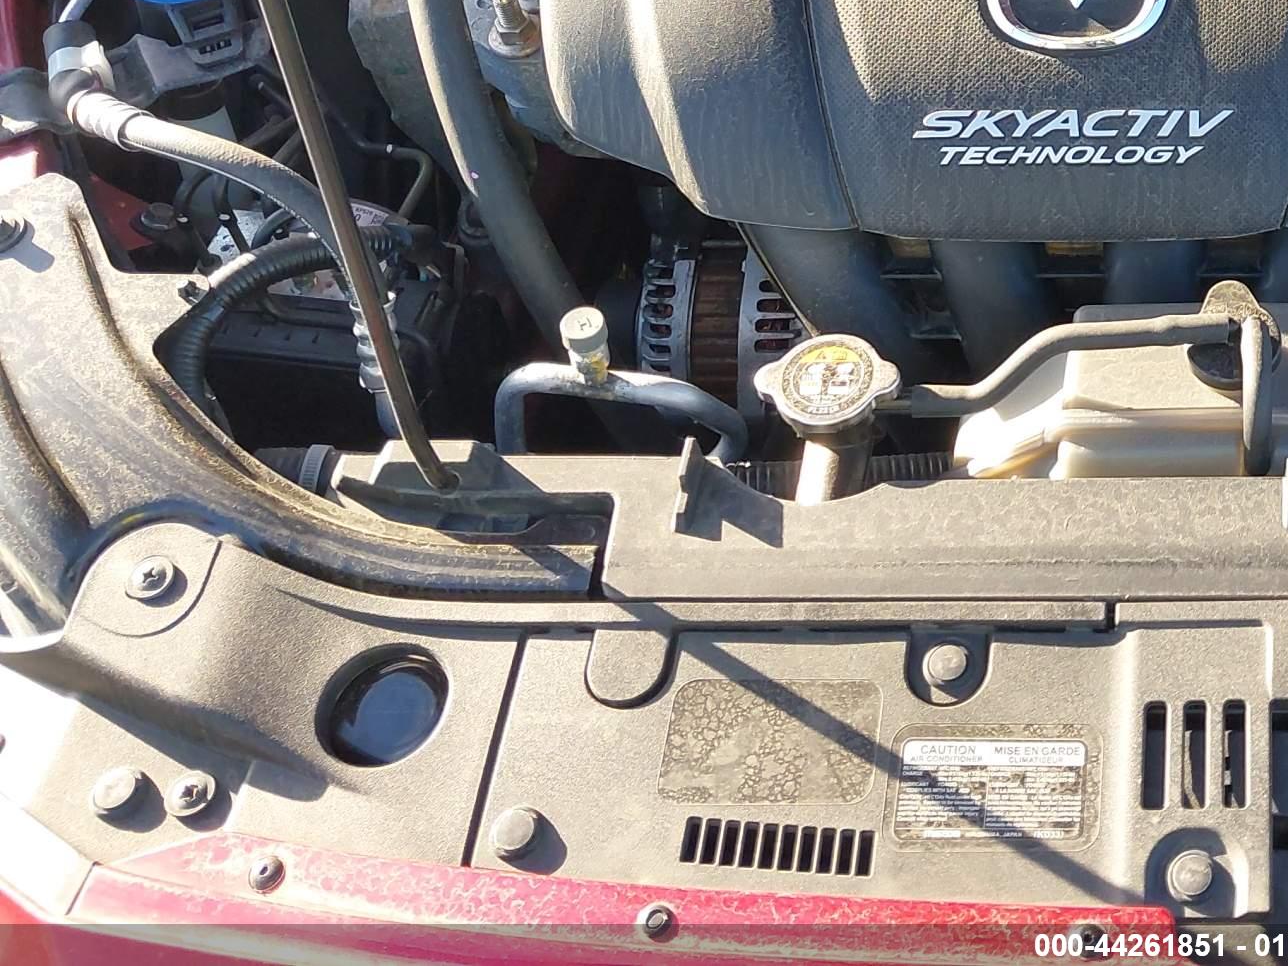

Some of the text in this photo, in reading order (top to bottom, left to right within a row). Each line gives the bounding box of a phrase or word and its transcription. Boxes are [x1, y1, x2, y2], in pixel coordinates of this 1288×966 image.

[912, 109, 1235, 139] SKYACTIV
[939, 145, 1205, 165] TECHNOLOGY
[920, 745, 977, 755] CAUTION
[994, 746, 1081, 756] MISE EN GARDE
